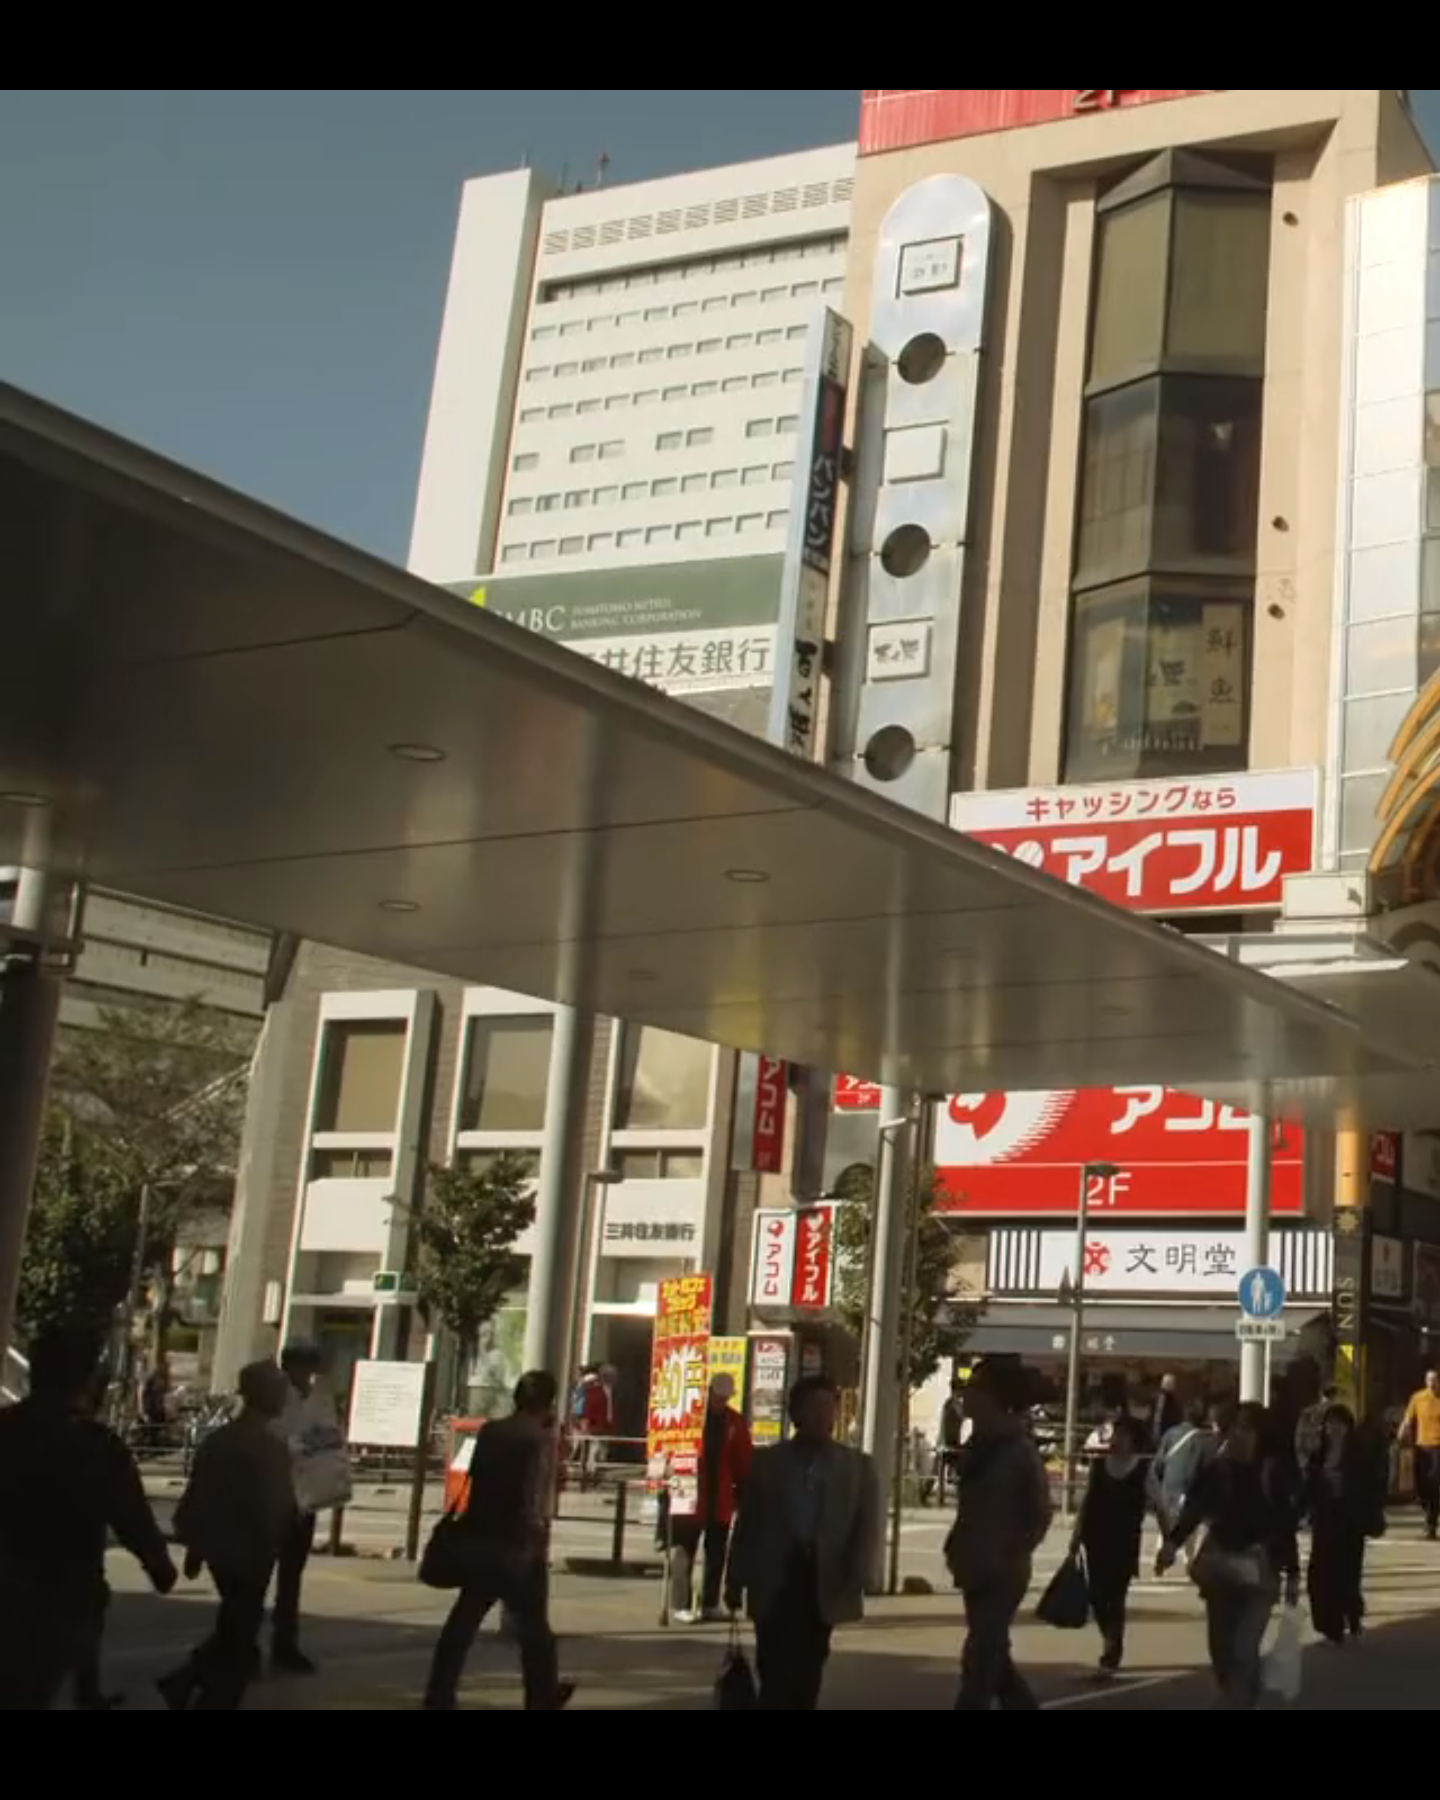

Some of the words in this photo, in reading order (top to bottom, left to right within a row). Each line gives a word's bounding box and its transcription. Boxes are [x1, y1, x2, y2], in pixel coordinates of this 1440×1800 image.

[502, 604, 567, 633] MBC
[588, 637, 772, 681] 井住友銀行
[1026, 786, 1238, 822] キャッシングなら
[1051, 826, 1283, 897] アイフル
[1087, 1172, 1132, 1205] 2F
[802, 1231, 820, 1302] アイフル
[1126, 1242, 1238, 1278] 文明堂
[1336, 1276, 1355, 1330] SUN
